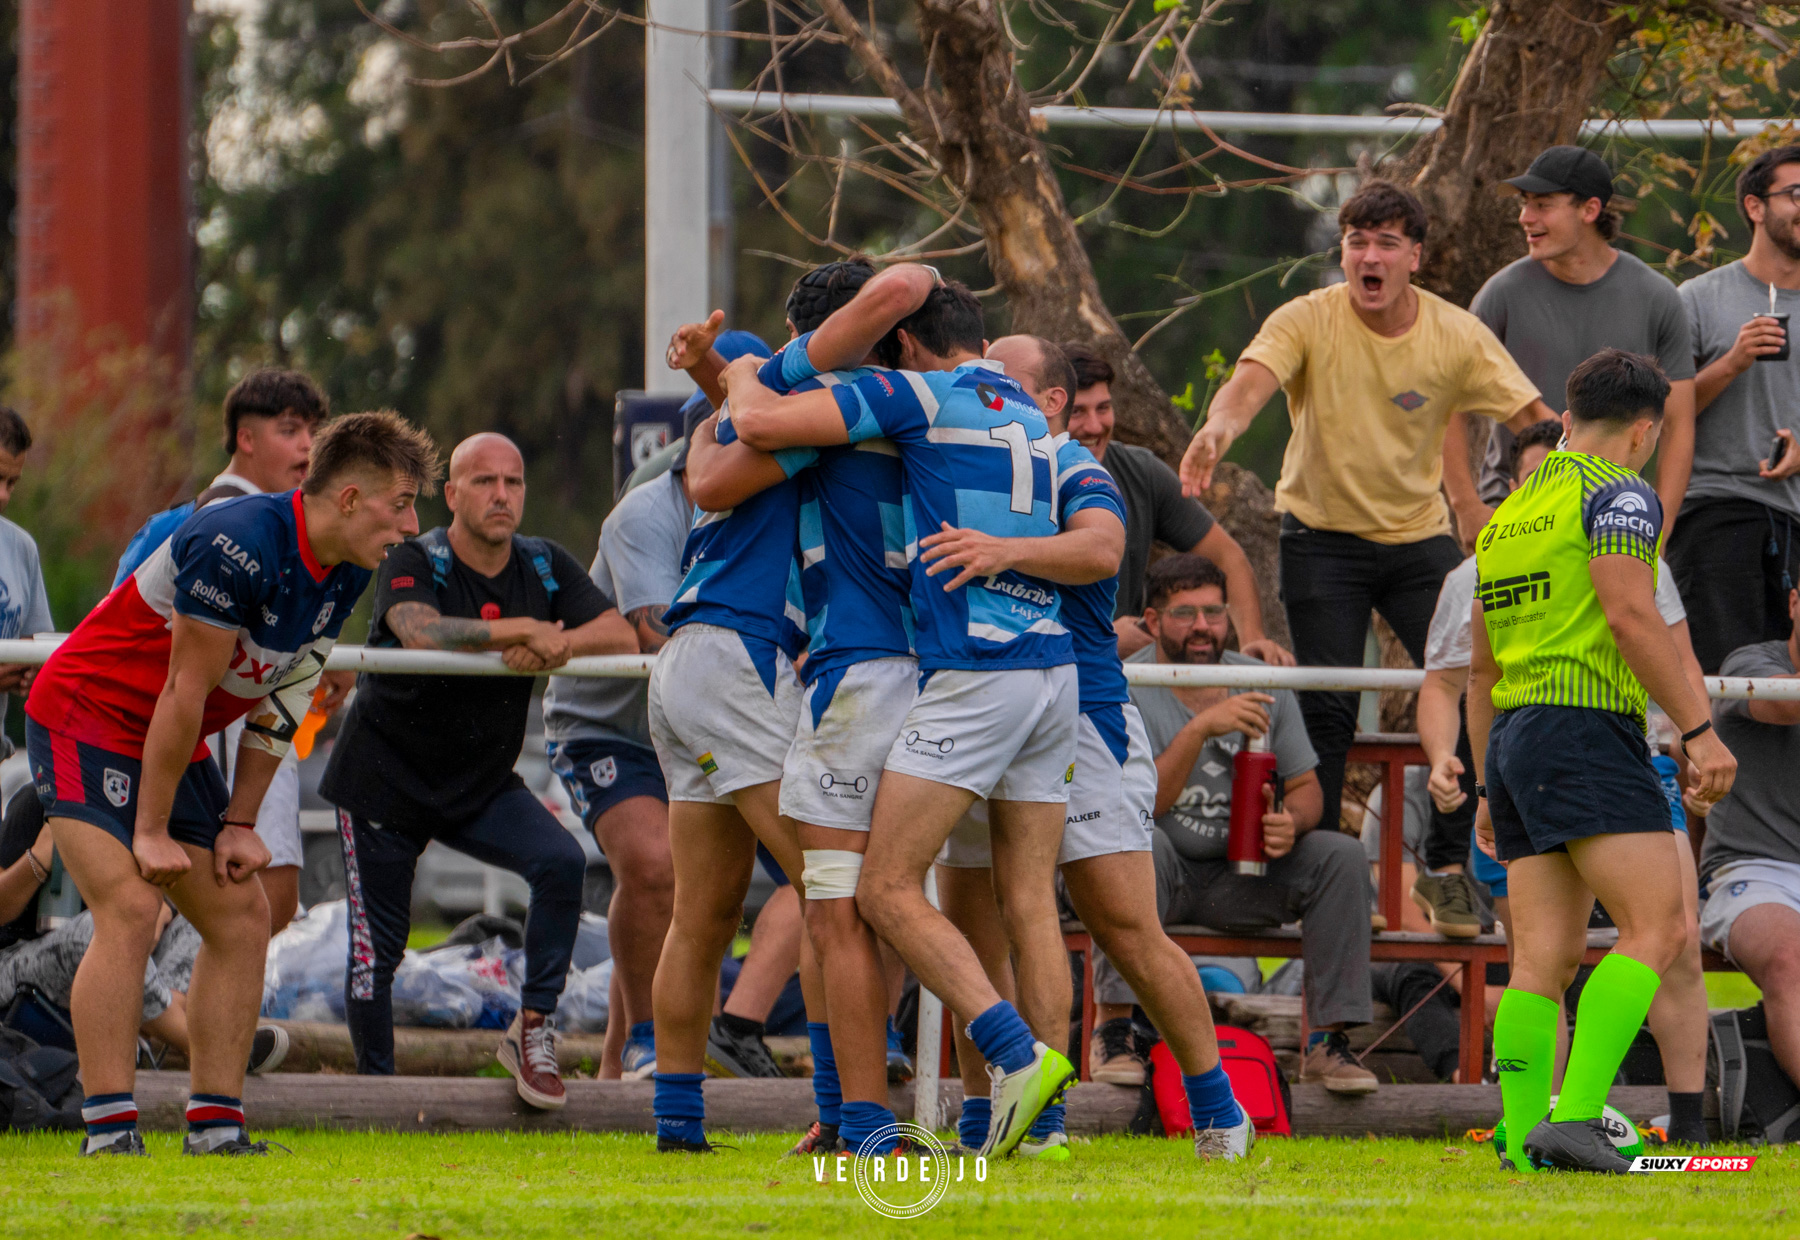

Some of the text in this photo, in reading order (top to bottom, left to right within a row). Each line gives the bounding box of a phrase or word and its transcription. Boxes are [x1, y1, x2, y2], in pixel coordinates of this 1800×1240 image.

[989, 420, 1058, 528] 11
[1498, 514, 1556, 540] ZURICH
[1593, 509, 1655, 538] Macro
[211, 532, 261, 577] FUAR
[1481, 571, 1551, 613] ESPN
[905, 747, 945, 760] PURA SANGRE
[822, 790, 864, 800] PURA SANGRE
[1066, 810, 1101, 825] ALKER
